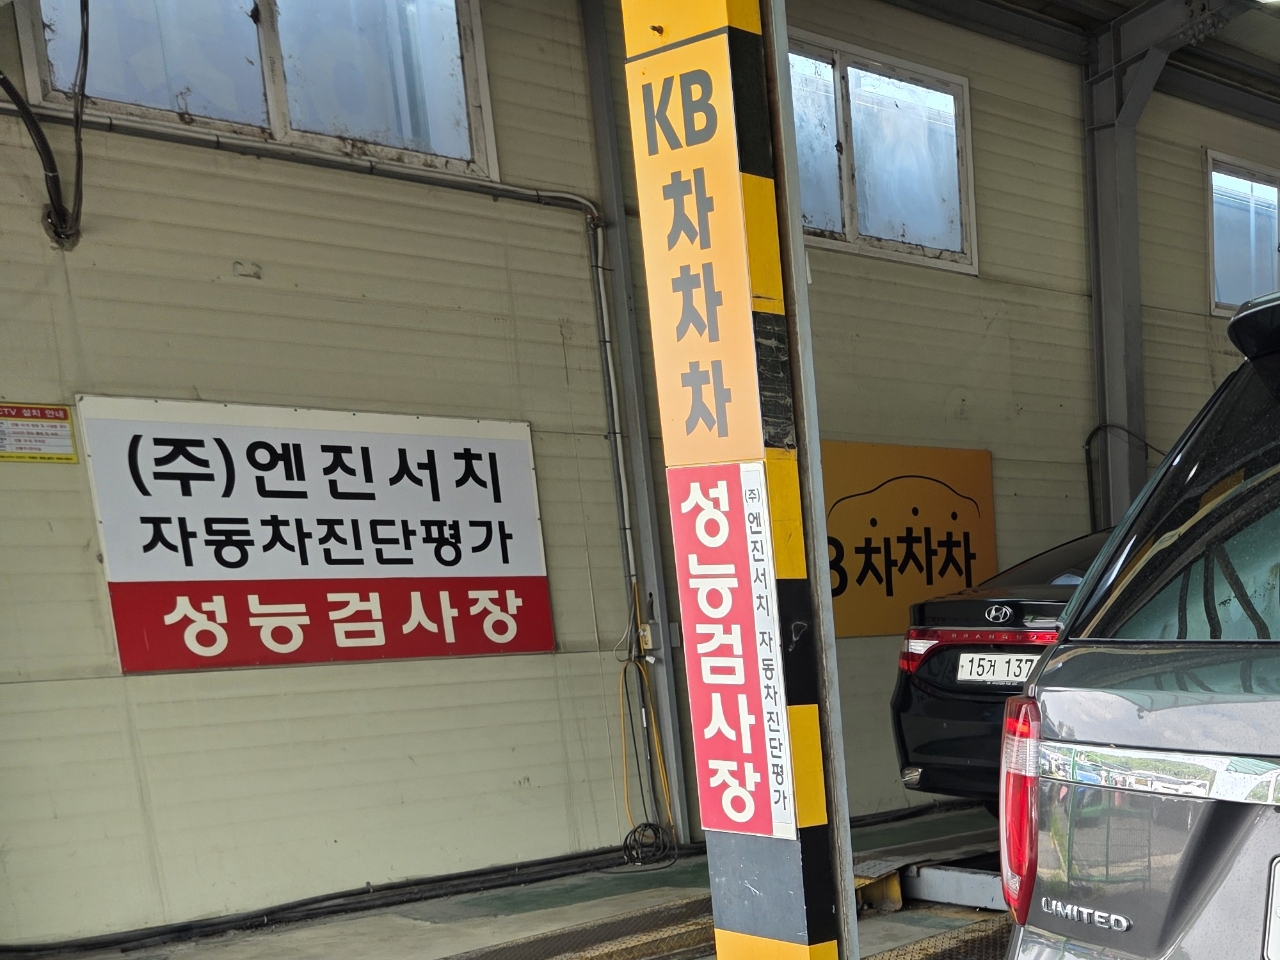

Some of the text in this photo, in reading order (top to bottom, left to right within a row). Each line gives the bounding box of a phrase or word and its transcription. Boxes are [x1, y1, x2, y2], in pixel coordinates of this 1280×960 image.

[641, 69, 718, 157] KB
[662, 167, 733, 439] 차차차
[140, 514, 514, 569] 자동차진단평가
[854, 526, 977, 597] 차차차
[163, 589, 524, 657] 성능검사장
[681, 480, 762, 823] 성능검사장
[968, 657, 997, 676] 15거
[1041, 896, 1134, 932] LIMITED
